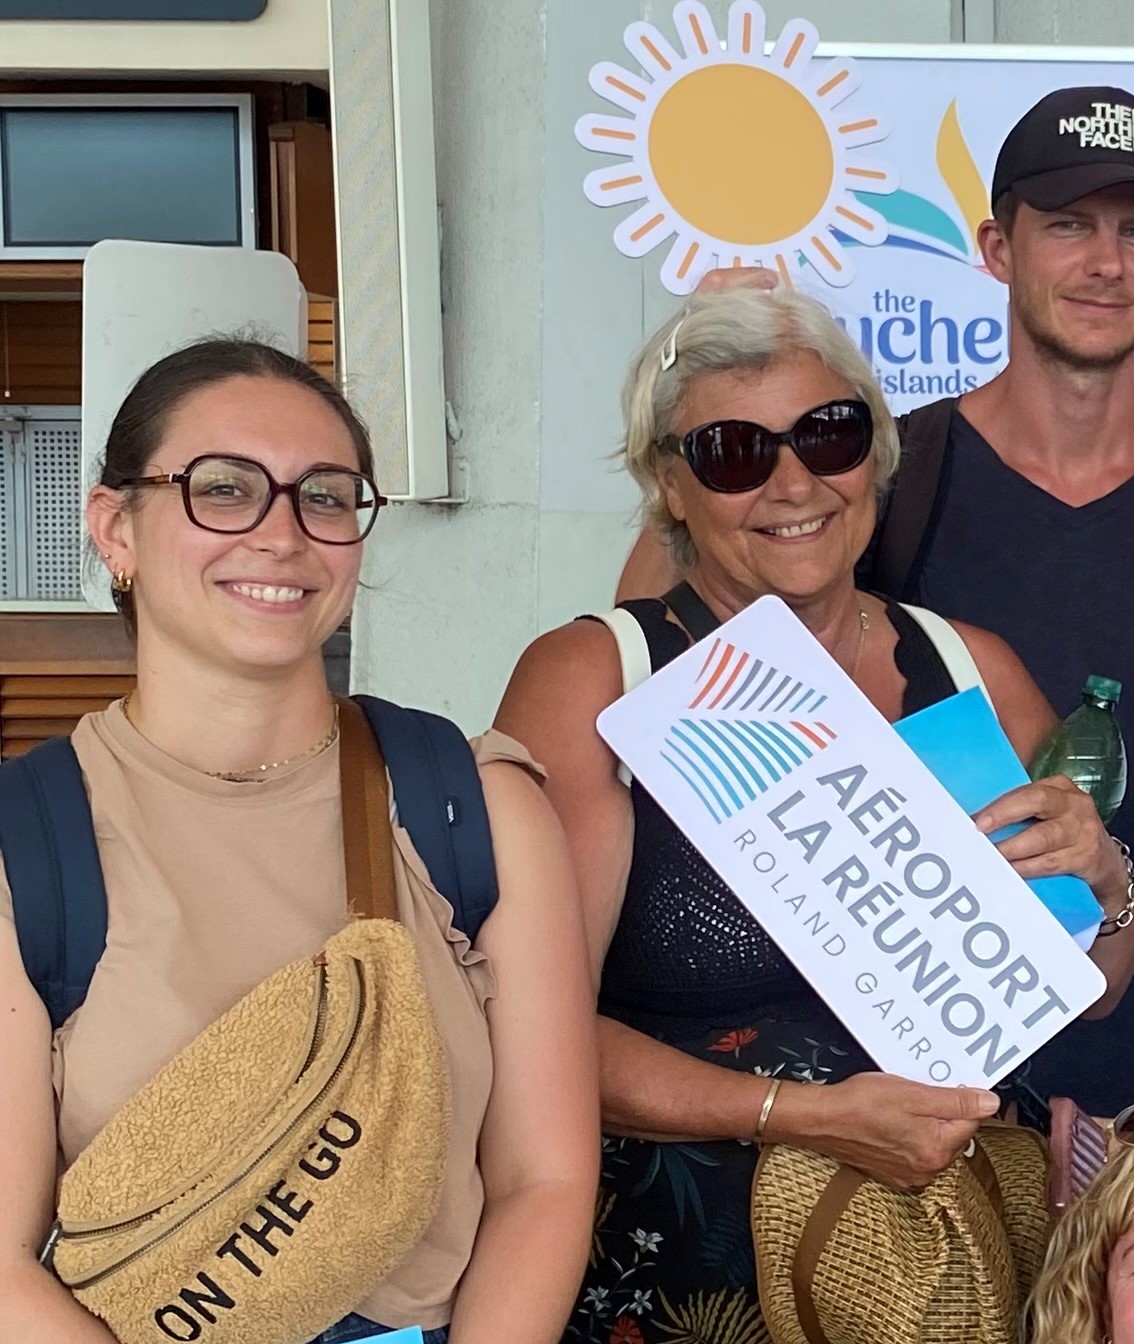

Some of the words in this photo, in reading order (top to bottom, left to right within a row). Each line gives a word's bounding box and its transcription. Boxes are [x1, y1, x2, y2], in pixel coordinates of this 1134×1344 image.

[1059, 116, 1132, 137] NORTH
[1080, 131, 1133, 152] FACE
[1091, 102, 1132, 120] THE
[873, 289, 916, 313] the
[733, 829, 847, 957] ROLAND
[855, 972, 967, 1089] GARRO
[767, 789, 832, 865] LA
[822, 854, 1021, 1078] RÉUNION
[816, 764, 1070, 1029] AÉROPORT
[154, 1270, 236, 1342] ON
[216, 1179, 314, 1277] THE
[298, 1110, 363, 1180] GO
